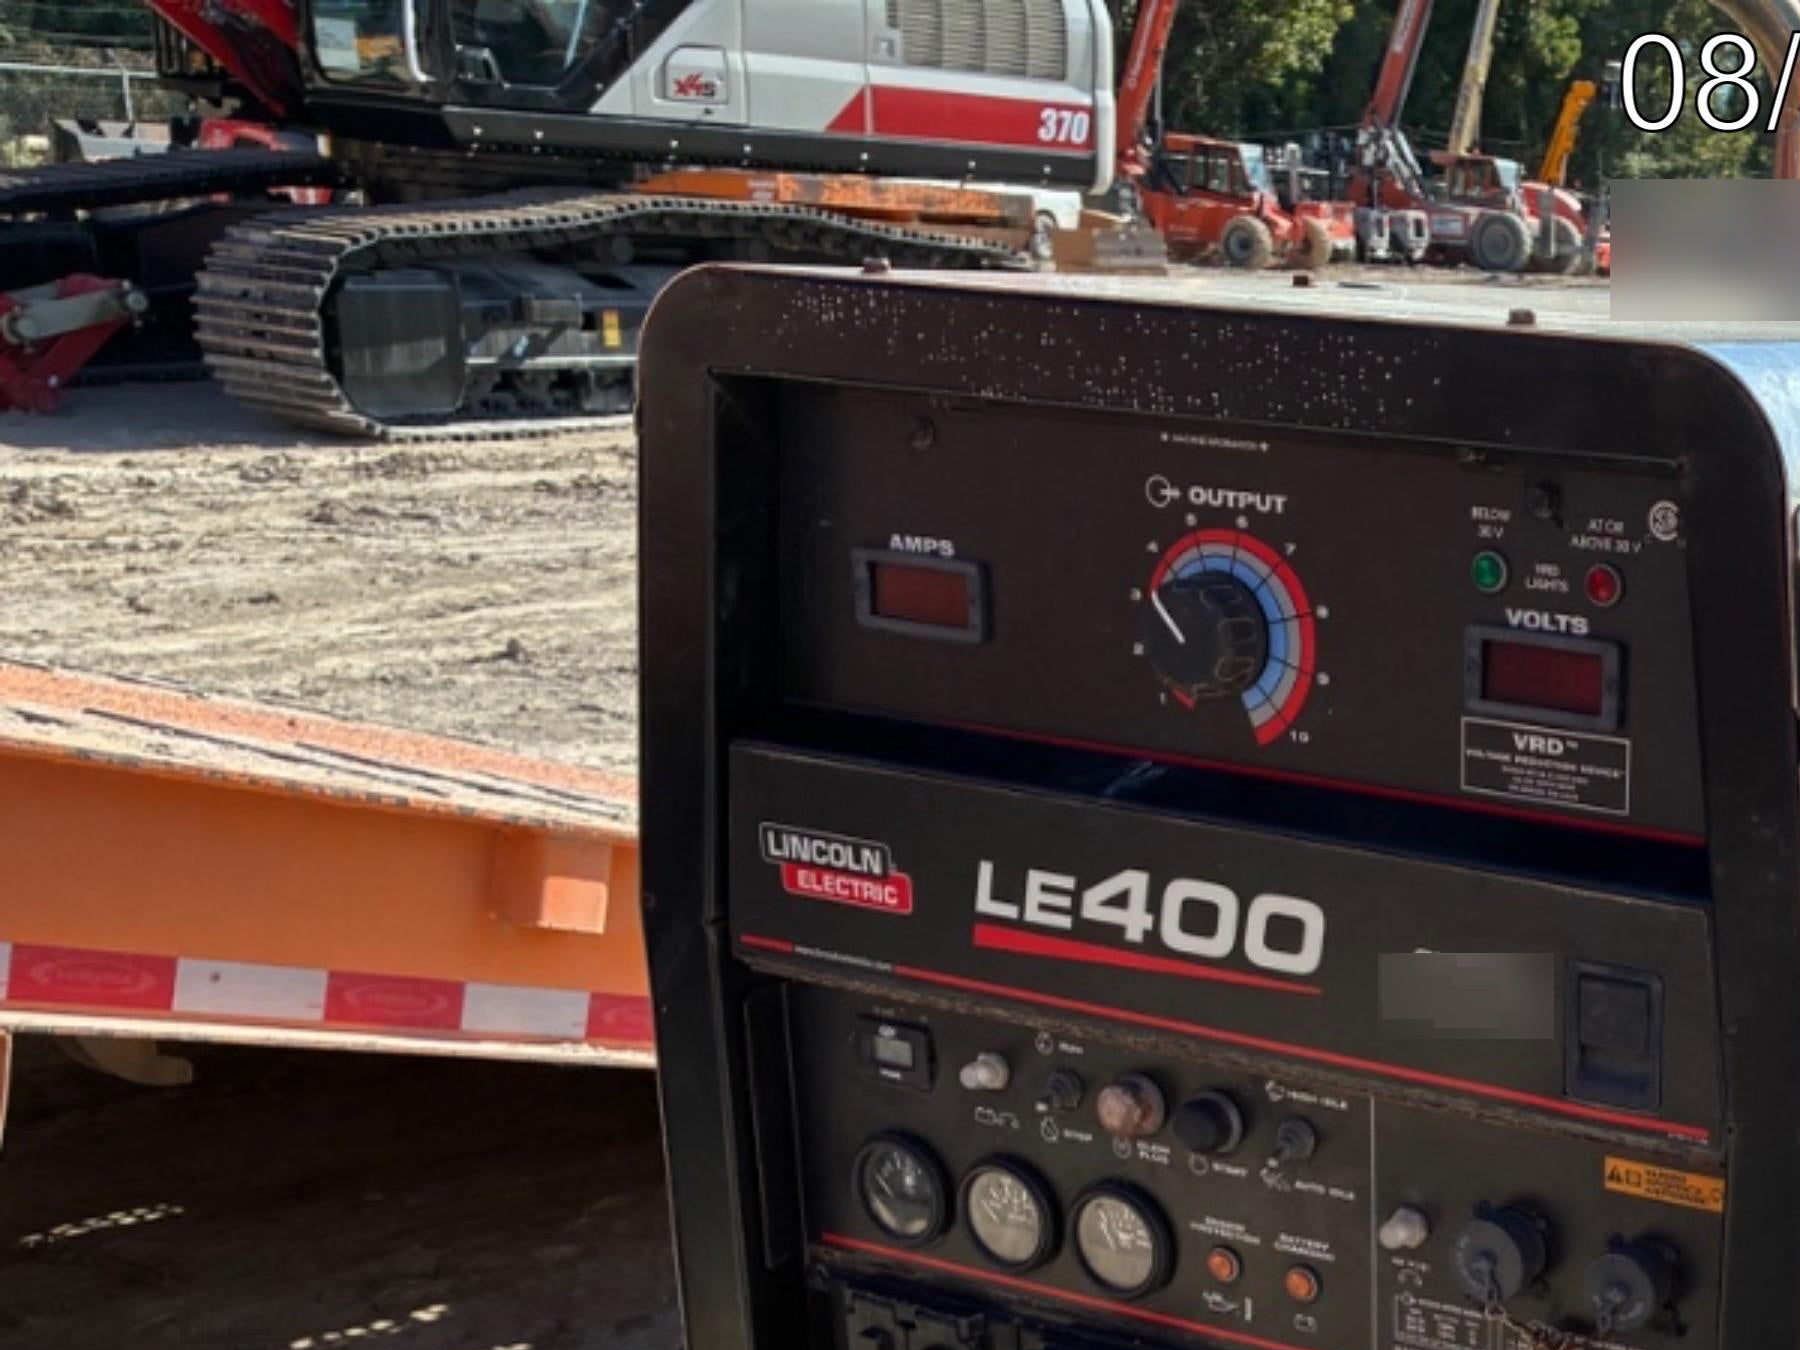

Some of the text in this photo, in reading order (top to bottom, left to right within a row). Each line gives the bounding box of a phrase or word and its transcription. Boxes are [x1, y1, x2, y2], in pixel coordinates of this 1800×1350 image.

[1039, 107, 1090, 144] 370
[1187, 485, 1288, 514] OUTPUT
[889, 533, 955, 557] AMPS
[1505, 607, 1589, 635] VOLTS
[766, 830, 883, 875] LINCOLN
[797, 868, 898, 904] ELECTRIC
[974, 860, 1326, 975] LE400
